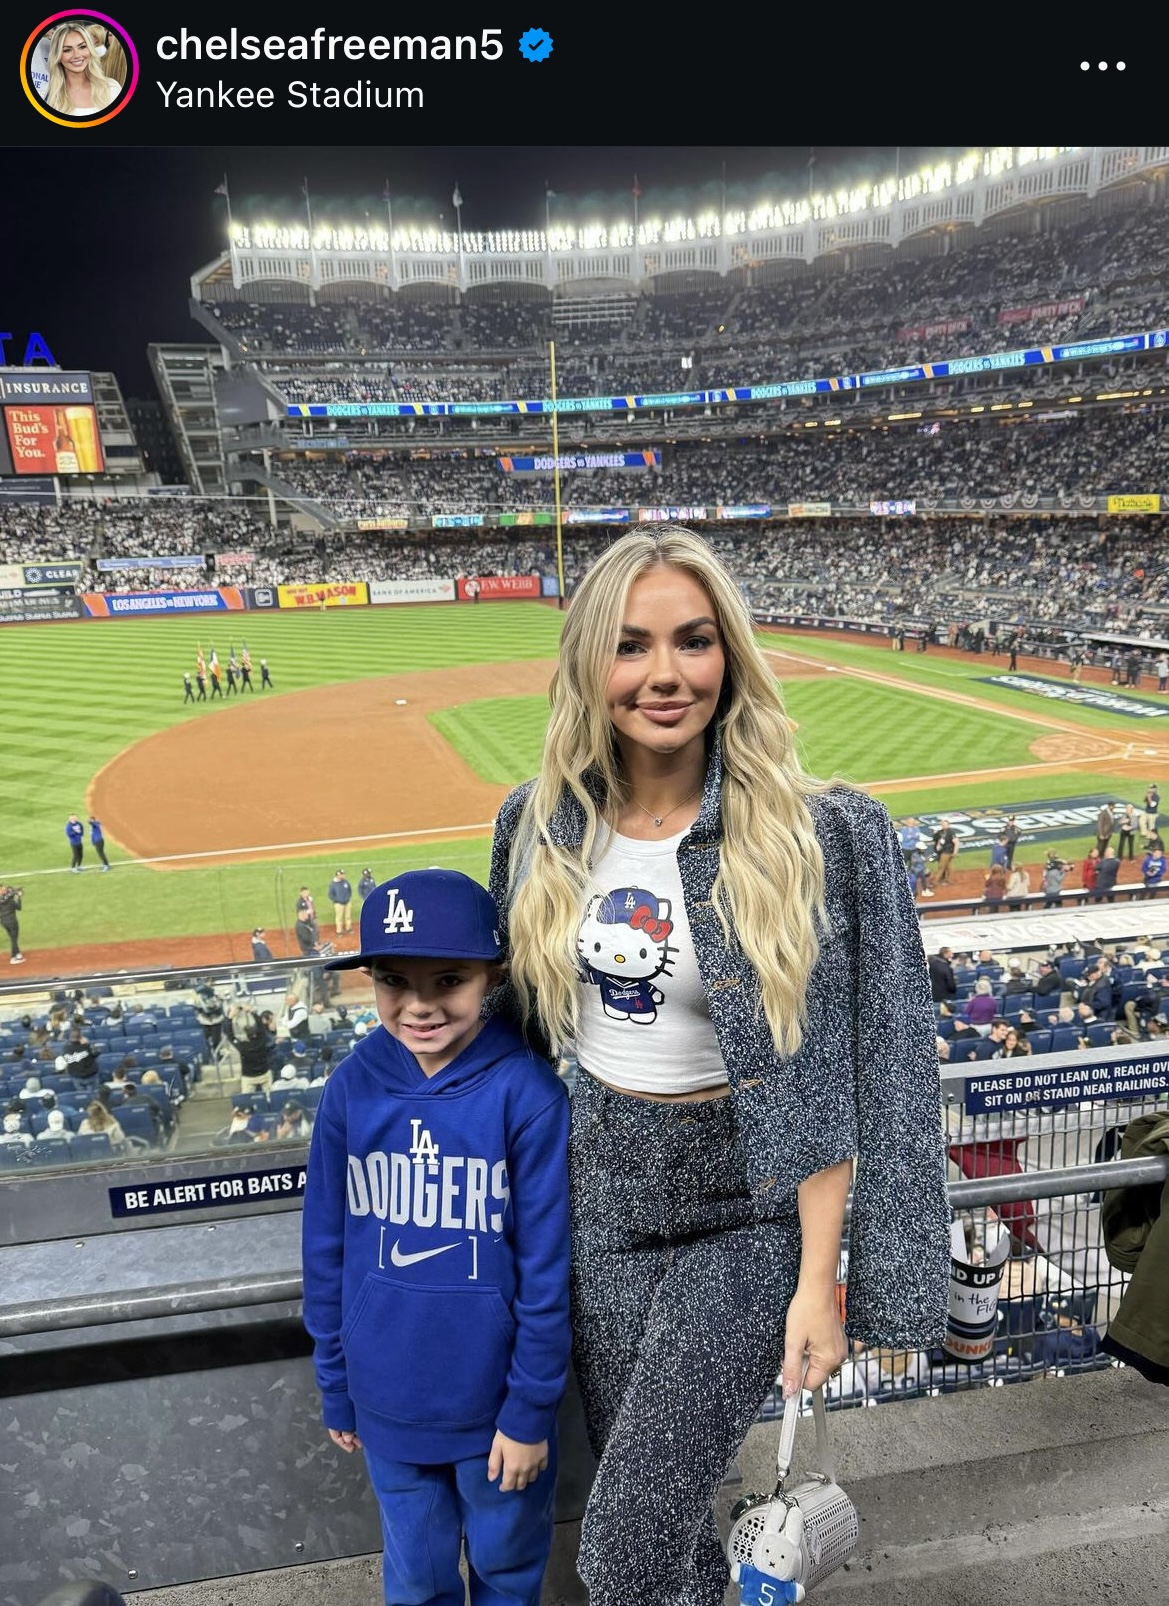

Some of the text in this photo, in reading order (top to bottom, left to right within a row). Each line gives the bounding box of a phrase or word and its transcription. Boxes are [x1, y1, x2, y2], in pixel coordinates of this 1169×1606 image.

[6, 382, 89, 394] INSURANCE
[9, 410, 41, 422] This
[13, 422, 49, 434] Bud's
[14, 434, 38, 446] For
[15, 446, 46, 458] You.
[585, 454, 625, 468] YANKEES
[405, 587, 437, 595] AMERICA
[624, 892, 636, 909] LA
[383, 888, 414, 934] LA
[609, 988, 641, 1000] Dodgers
[970, 1077, 1015, 1094] PLEASE
[1016, 1076, 1032, 1088] DO
[1034, 1073, 1059, 1087] NOT
[1060, 1069, 1089, 1084] LEAN
[1092, 1067, 1111, 1082] ON,
[1113, 1062, 1150, 1078] REACH
[984, 1076, 1169, 1107] SIT ON OR STAND NEAR RAILINGS.
[409, 1119, 440, 1164] LA
[124, 1190, 149, 1210] BE
[153, 1183, 206, 1207] ALERT
[210, 1179, 245, 1200] FOR
[248, 1172, 293, 1195] BATS
[347, 1151, 511, 1234] DODGERS
[973, 1272, 996, 1285] UP
[968, 1293, 990, 1305] the
[758, 1582, 777, 1606] 5
